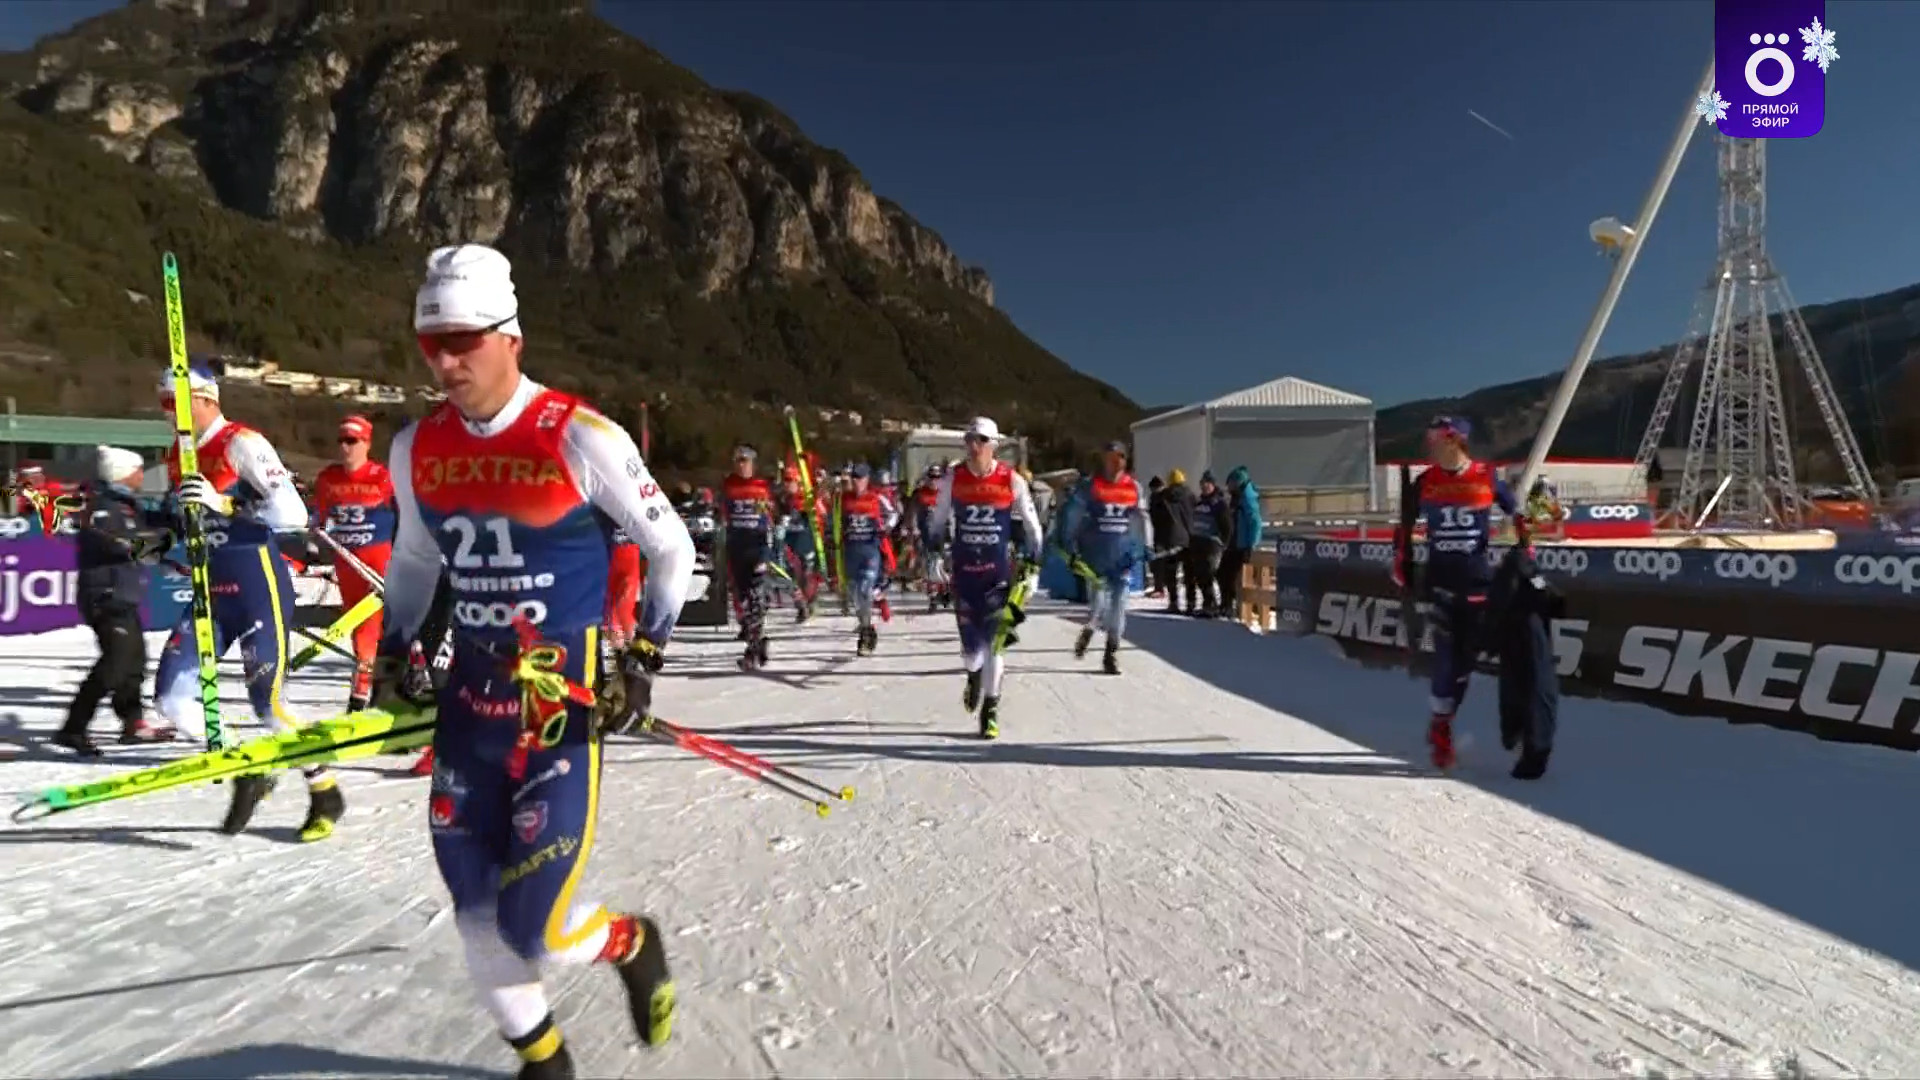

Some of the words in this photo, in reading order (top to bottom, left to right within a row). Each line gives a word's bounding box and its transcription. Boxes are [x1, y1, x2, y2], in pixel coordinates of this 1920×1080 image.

[965, 505, 996, 524] 22
[1440, 506, 1475, 527] 16
[1590, 504, 1639, 521] coop
[443, 515, 525, 568] 21
[961, 533, 1000, 546] coop
[1280, 541, 1305, 559] coop
[1315, 542, 1349, 561] coop
[1613, 550, 1682, 581] coop
[1714, 552, 1798, 587] coop
[1834, 554, 1920, 594] coop
